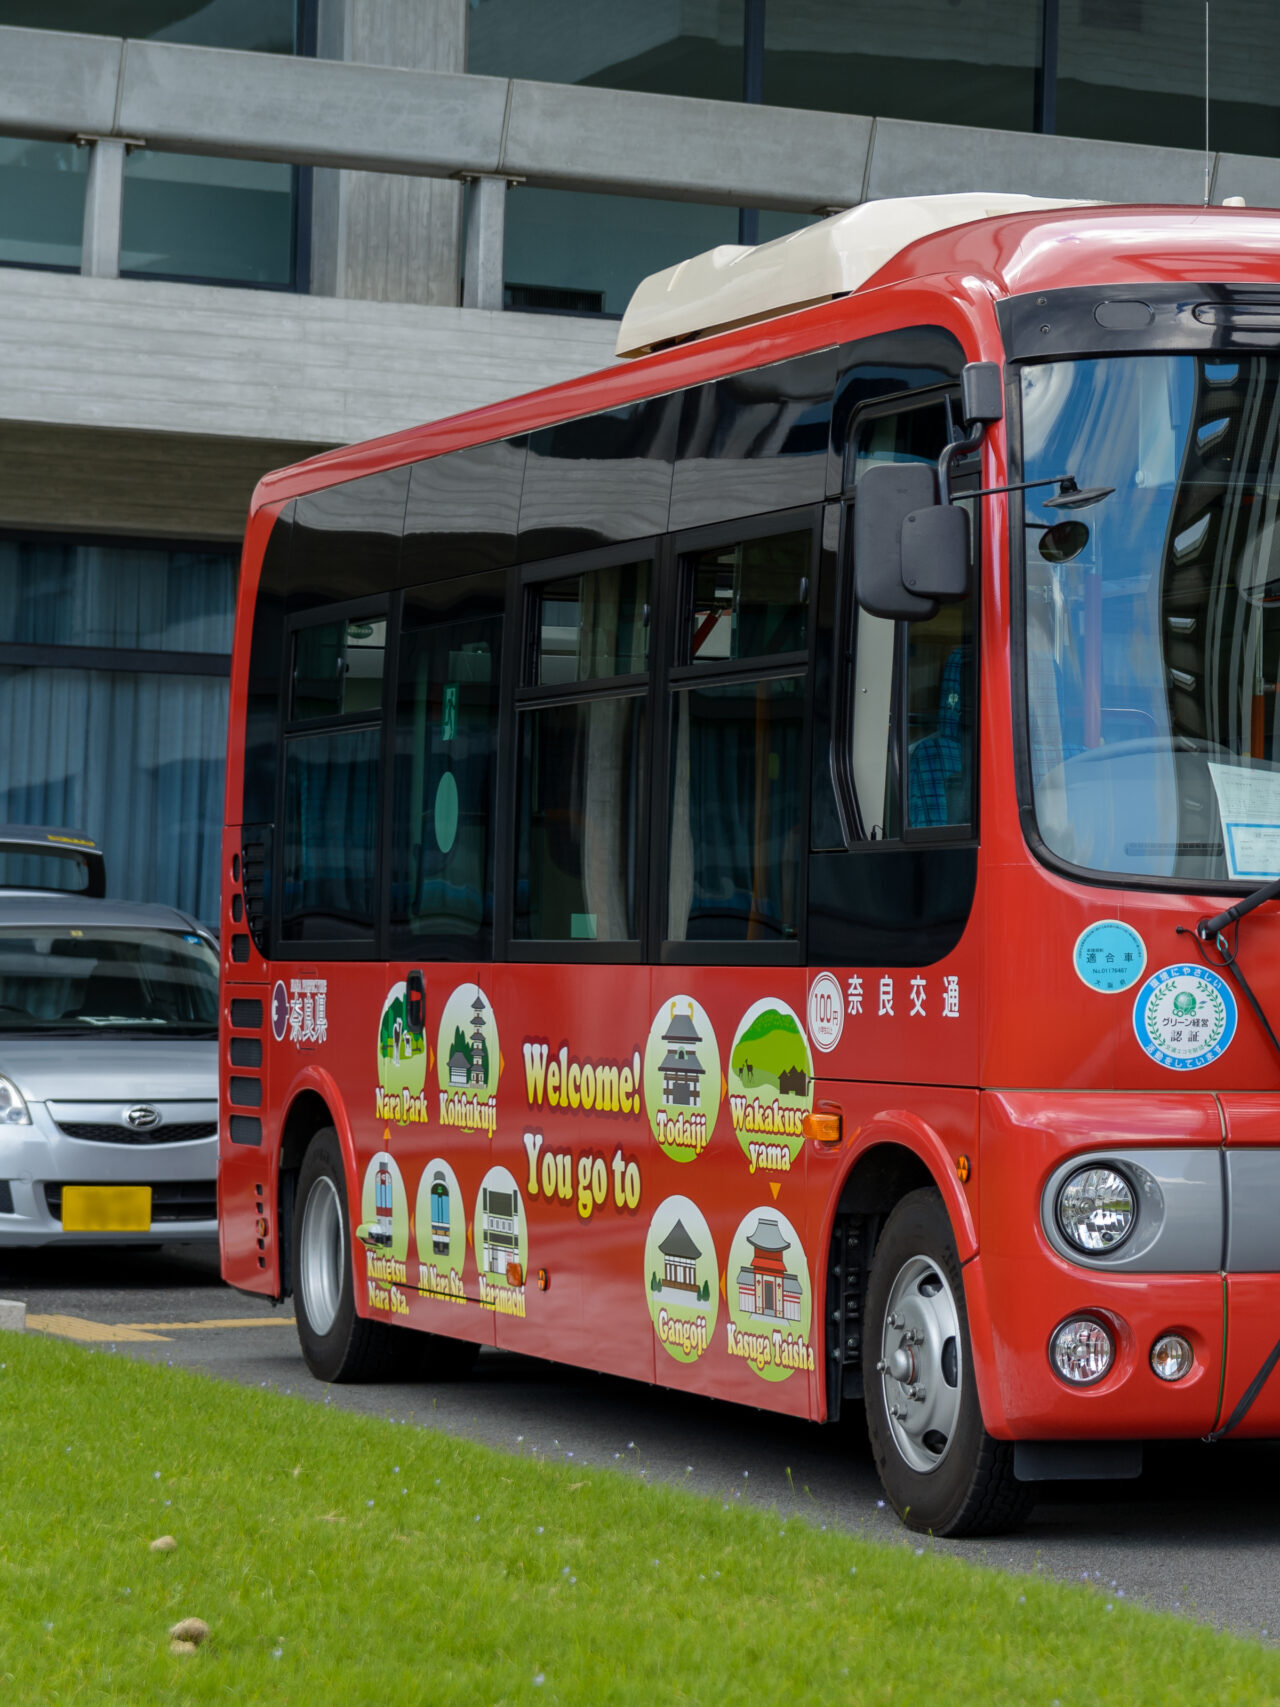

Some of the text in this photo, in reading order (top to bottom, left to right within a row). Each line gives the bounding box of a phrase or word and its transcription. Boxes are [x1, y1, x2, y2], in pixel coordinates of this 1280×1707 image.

[815, 993, 838, 1026] 100円
[848, 974, 960, 1018] 奈良交通
[1162, 1017, 1209, 1028] グリーン経営
[1171, 1030, 1199, 1042] 認証
[523, 1043, 641, 1114] Welcome!
[376, 1087, 428, 1123] Nara Park
[439, 1092, 497, 1138] Kohfukuji
[730, 1097, 809, 1136] Wakakus
[657, 1112, 707, 1154] Todaiji
[523, 1133, 641, 1218] You go to
[750, 1144, 791, 1174] yama
[367, 1251, 407, 1283] Kintetsu
[430, 1267, 451, 1301] Nara
[367, 1281, 410, 1315] Nara Sta.
[478, 1275, 527, 1318] Naramachi
[658, 1310, 708, 1356] Gangoji
[727, 1323, 815, 1371] Kasuga Taisha
